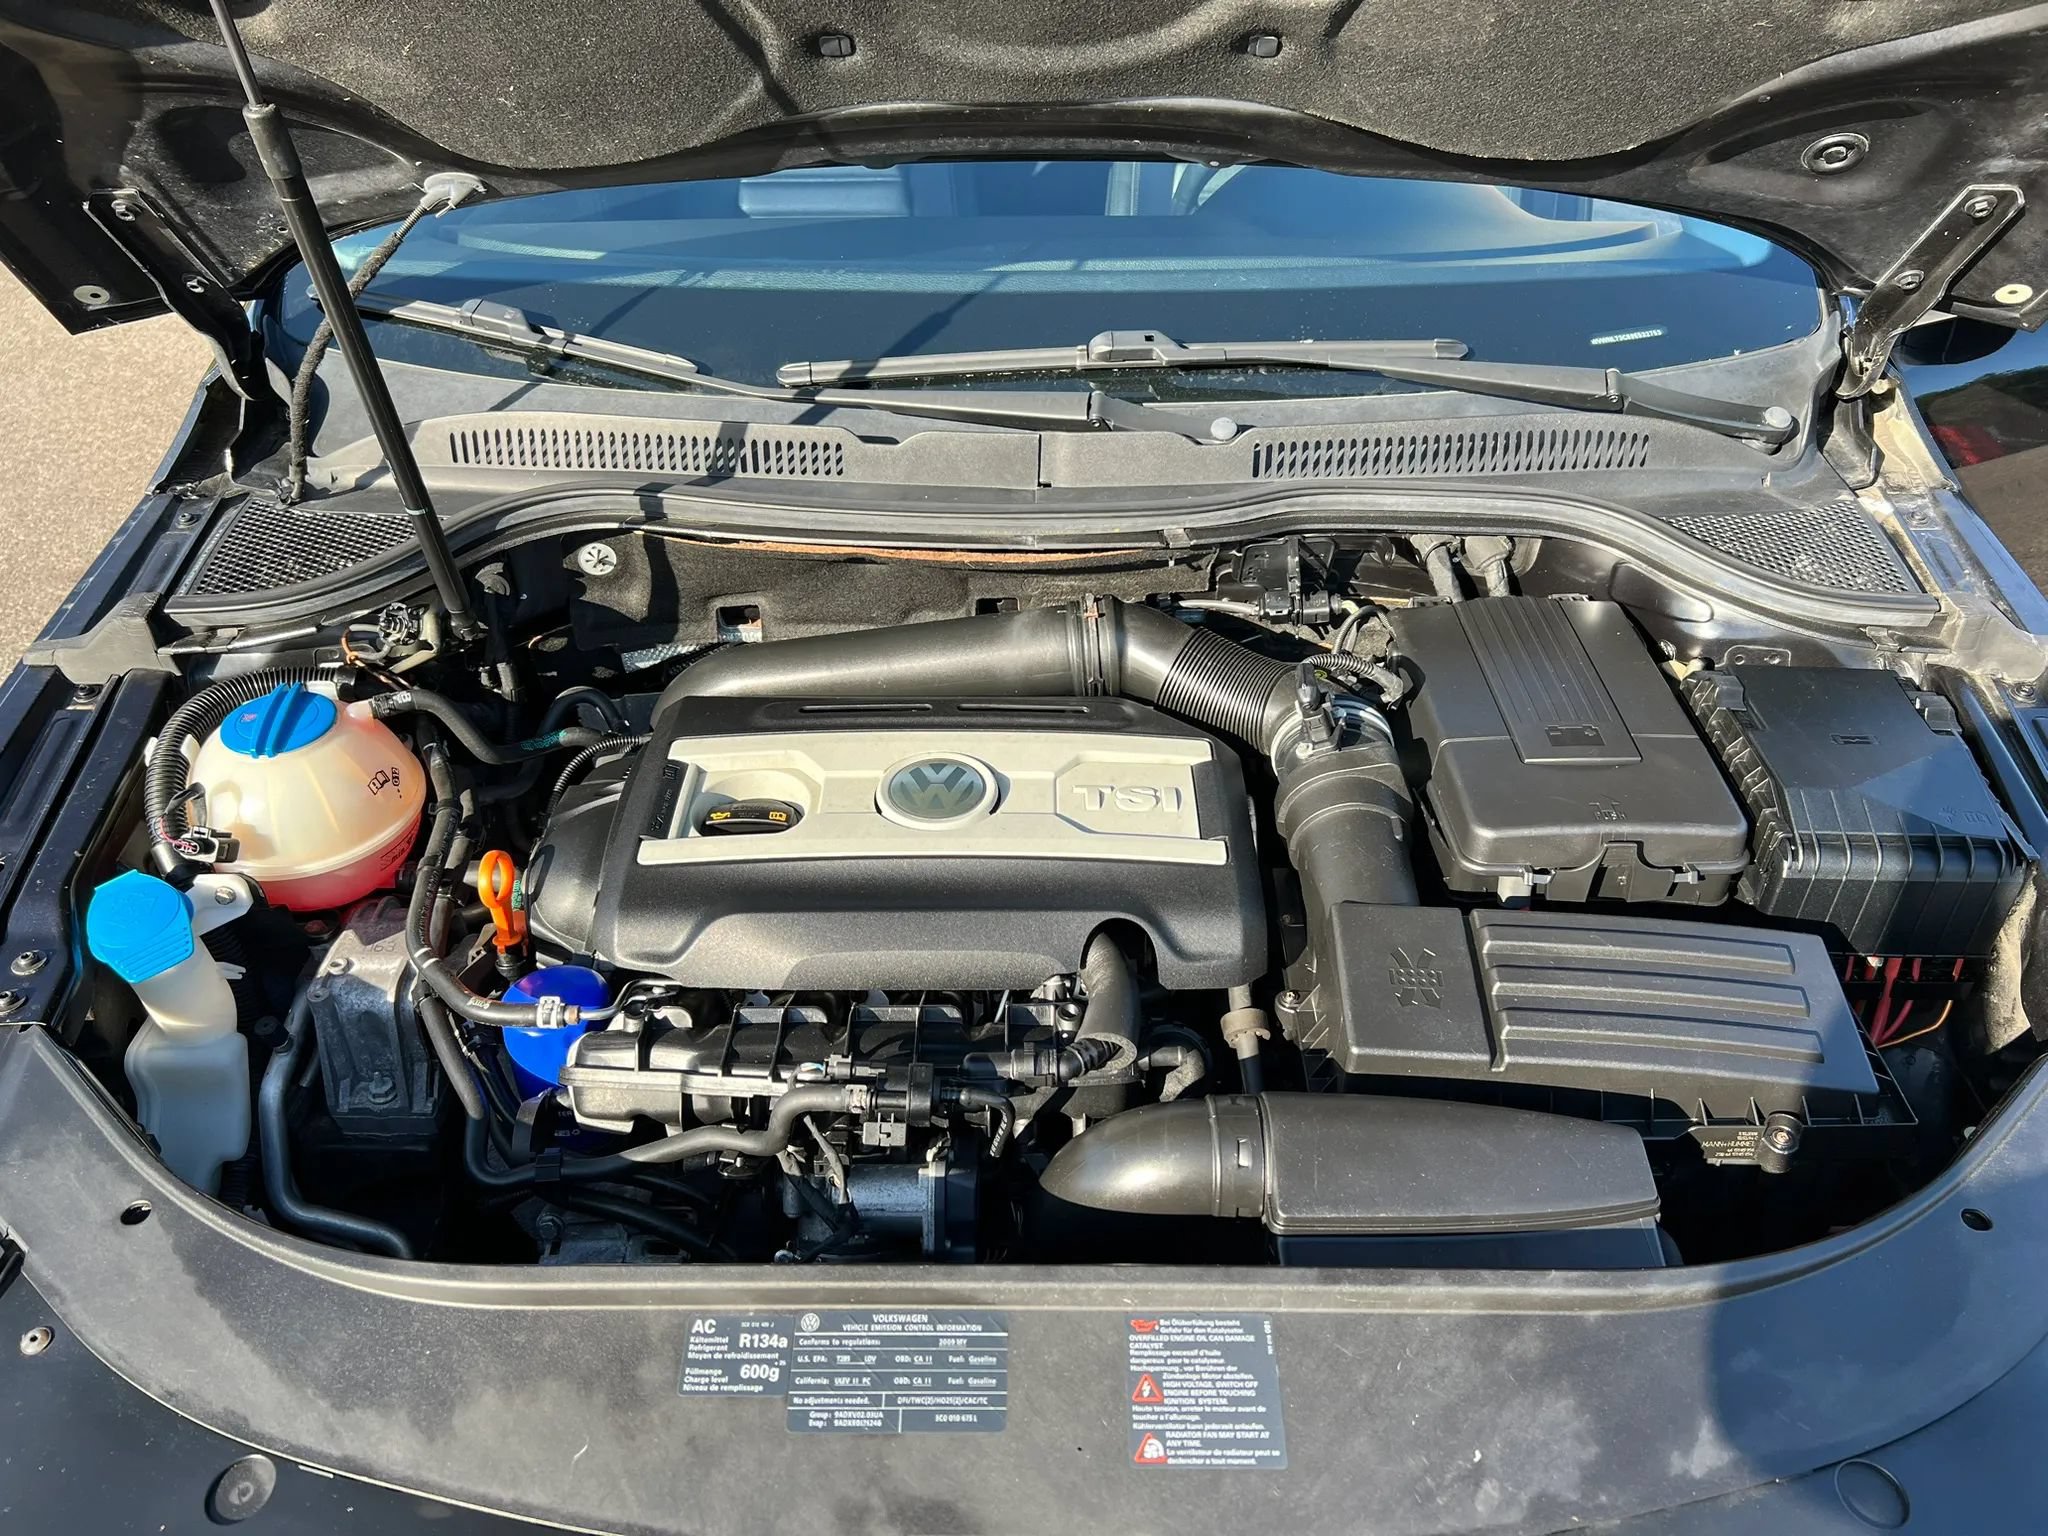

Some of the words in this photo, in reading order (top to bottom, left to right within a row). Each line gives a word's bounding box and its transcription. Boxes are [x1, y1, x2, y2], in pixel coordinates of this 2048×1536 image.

[1072, 785, 1183, 813] TSI
[873, 1314, 928, 1323] VOLKSWAGEN
[692, 1319, 716, 1334] AC
[739, 1333, 788, 1348] R134a
[842, 1338, 880, 1347] regulations:
[689, 1344, 728, 1352] Refrigerant
[688, 1352, 712, 1360] Moyen
[1130, 1350, 1171, 1358] Remplissage
[968, 1355, 997, 1363] Gasoline
[1130, 1357, 1165, 1366] dangereux
[1167, 1357, 1182, 1366] pour
[685, 1367, 722, 1376] Füllmenge
[740, 1364, 779, 1382] 600g
[684, 1376, 709, 1384] Charge
[968, 1377, 997, 1385] Gasoline
[720, 1384, 763, 1392] remplissage
[804, 1397, 843, 1405] adjustments
[1255, 1449, 1270, 1458] peut
